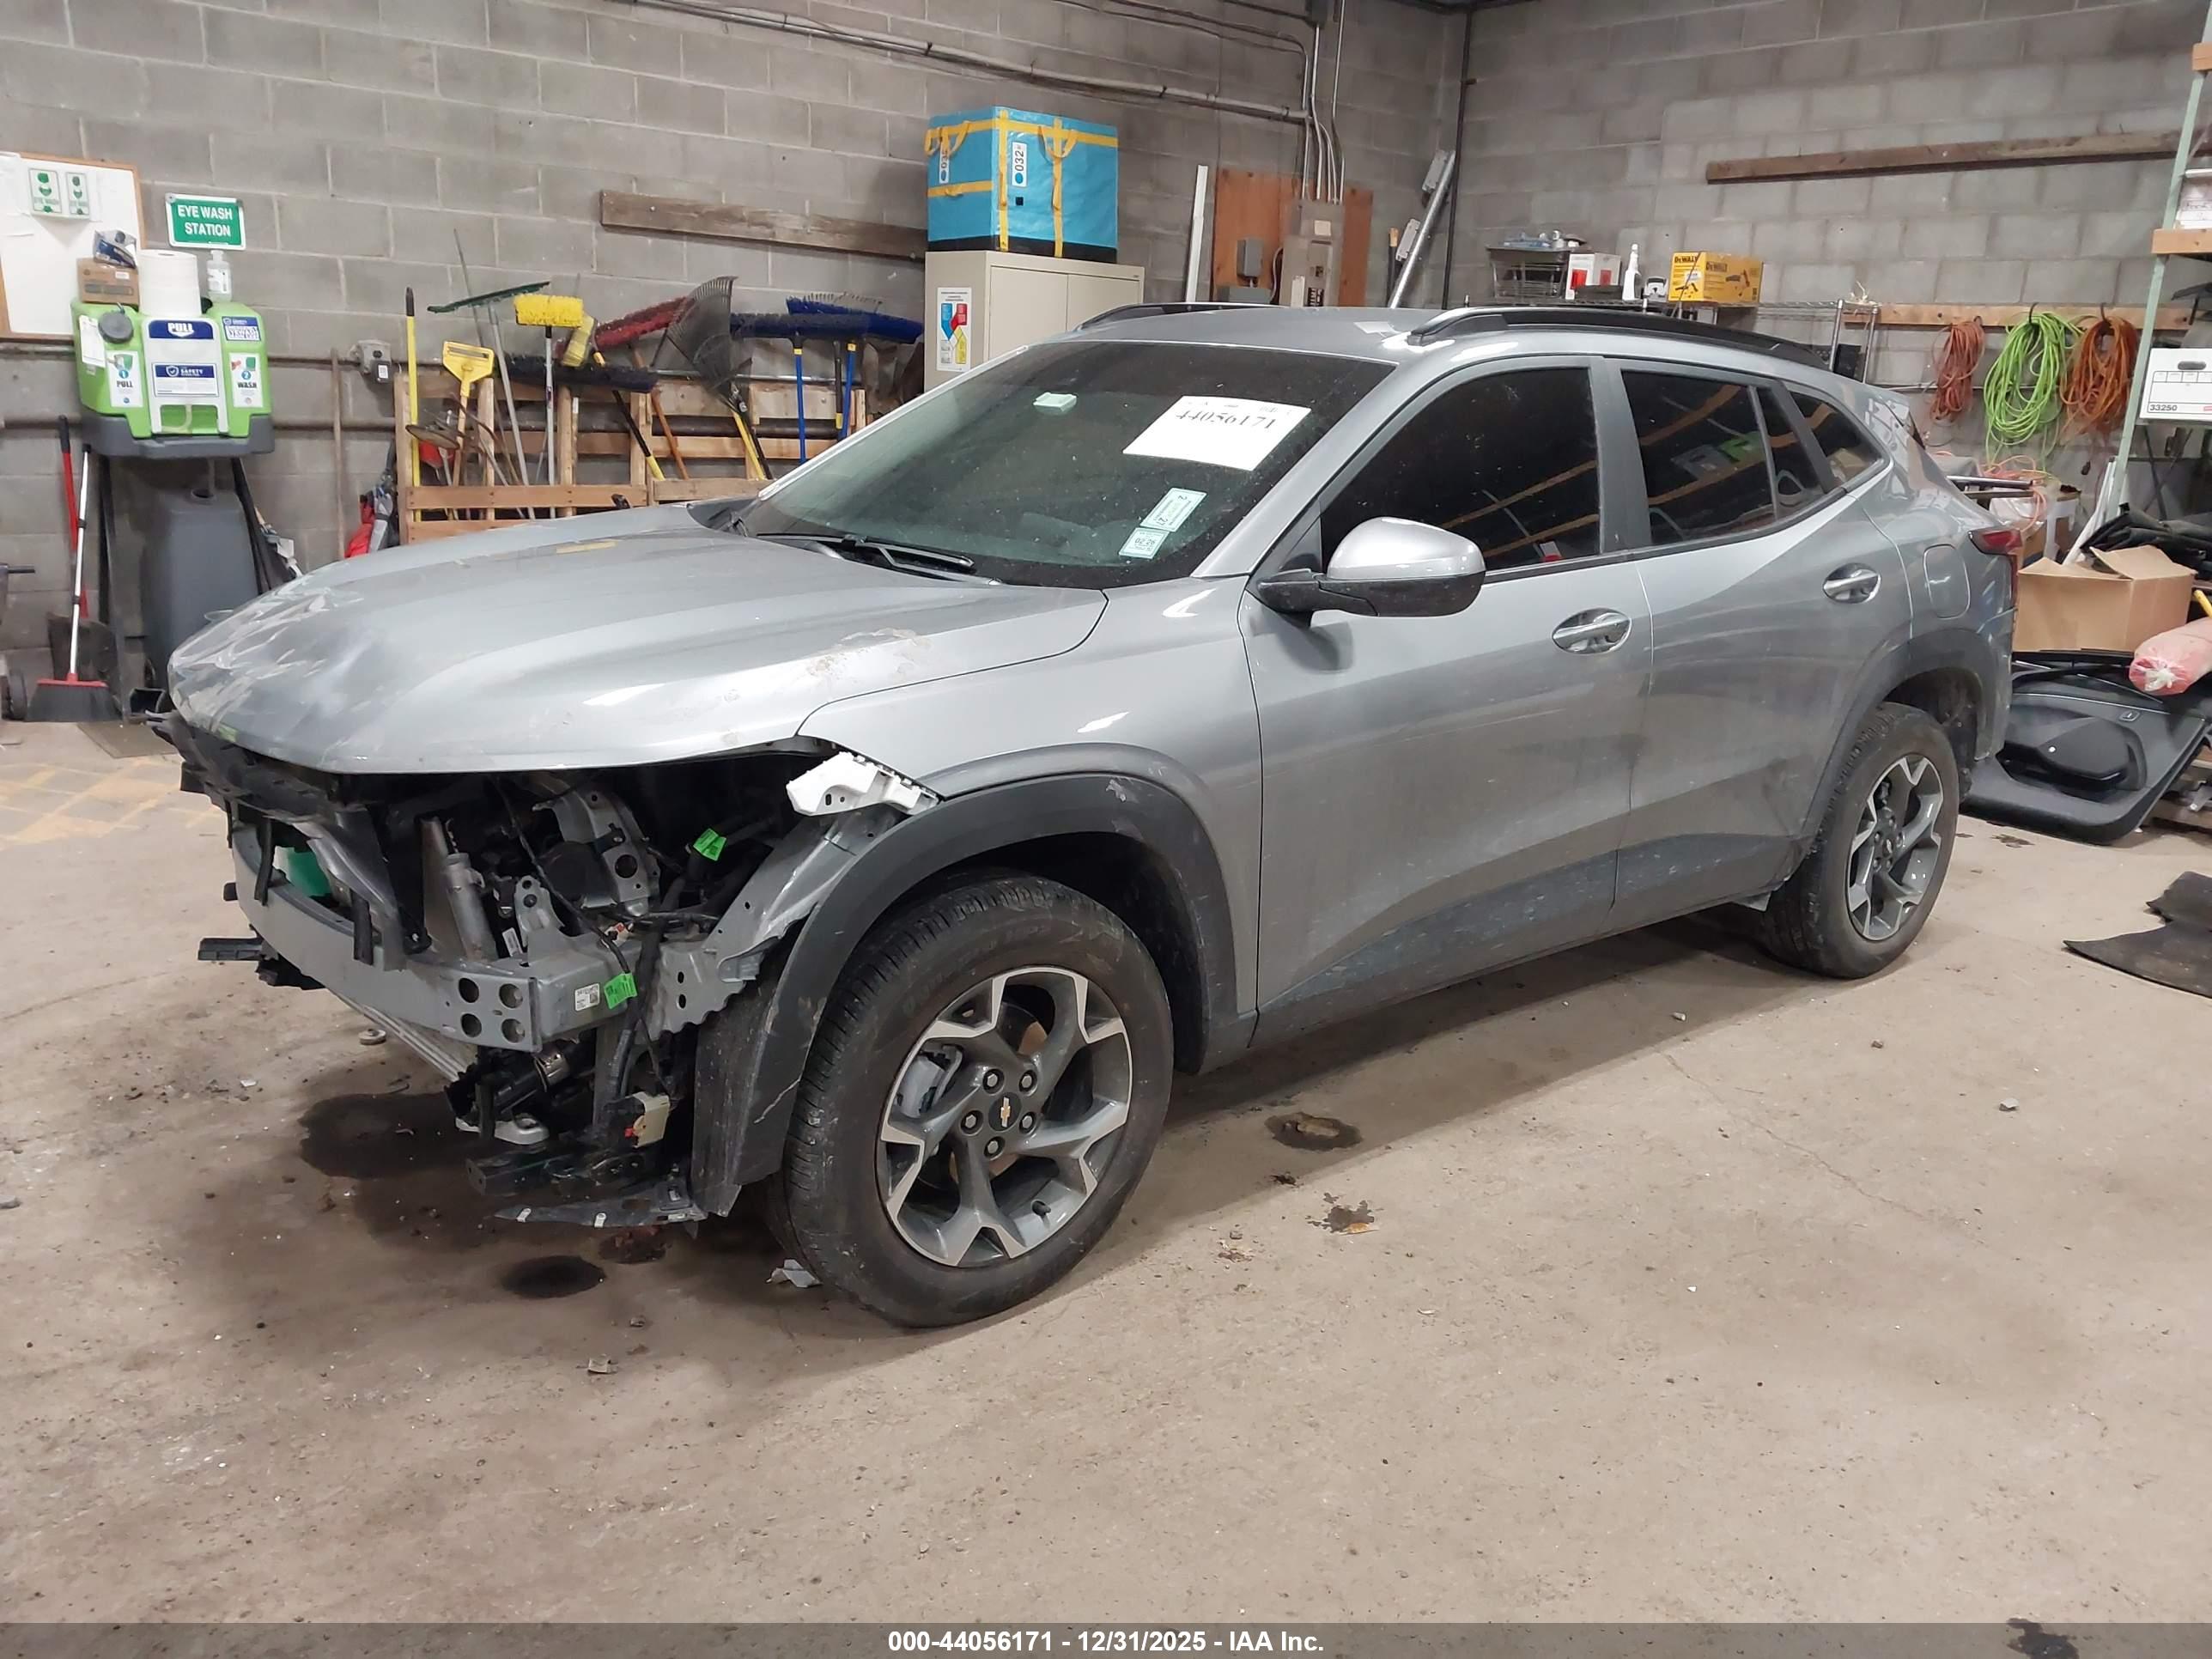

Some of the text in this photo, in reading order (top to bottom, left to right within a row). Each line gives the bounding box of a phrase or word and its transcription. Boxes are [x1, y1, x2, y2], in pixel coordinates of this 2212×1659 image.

[1014, 150, 1024, 172] 032
[177, 204, 233, 220] EYE WASH
[185, 222, 232, 237] STATION
[167, 322, 194, 333] PULL
[1176, 410, 1277, 429] 44056171
